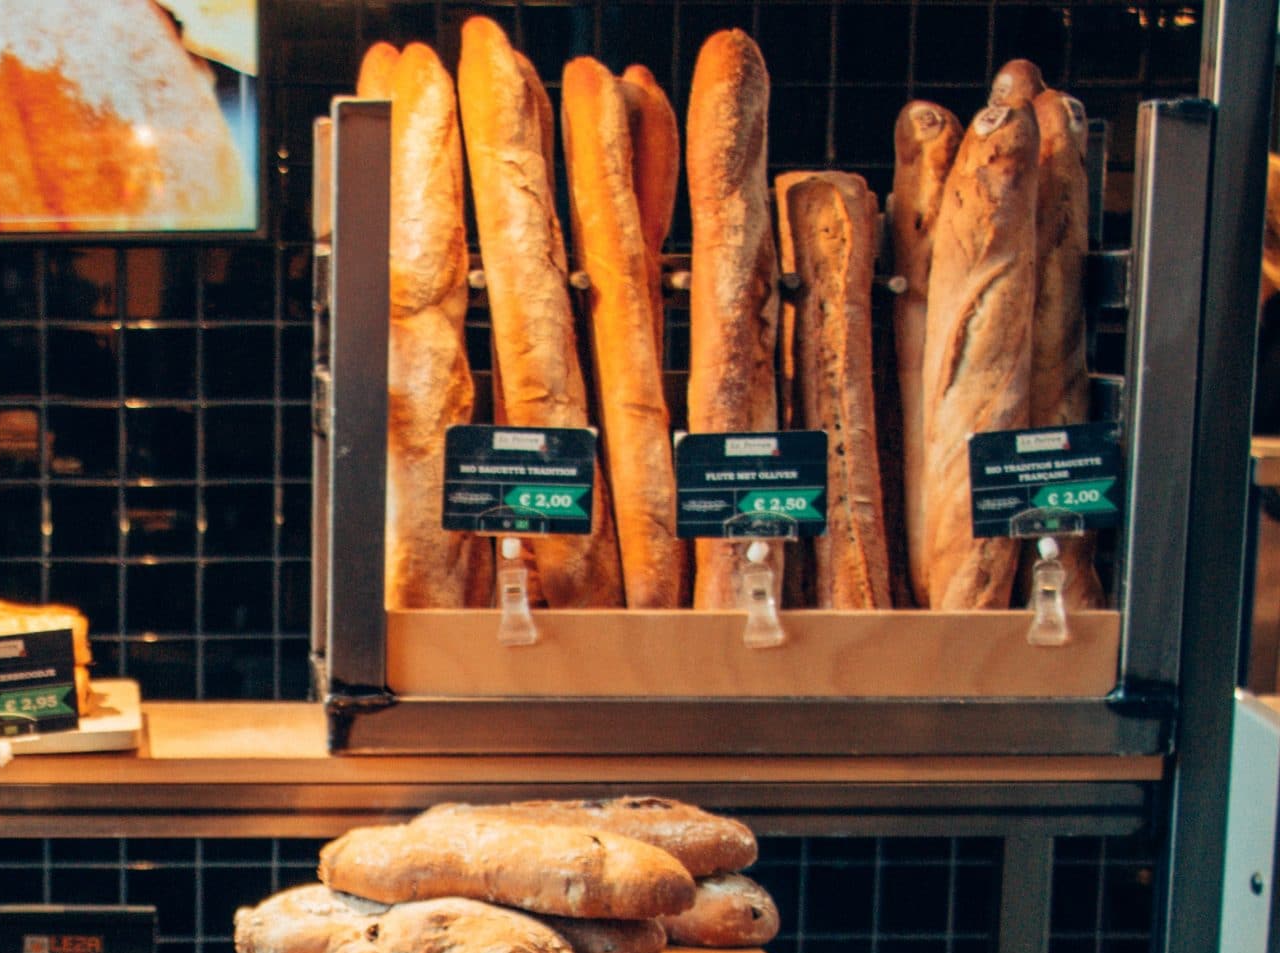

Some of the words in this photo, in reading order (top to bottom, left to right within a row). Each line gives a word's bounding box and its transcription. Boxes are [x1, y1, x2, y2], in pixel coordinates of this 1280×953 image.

[1003, 461, 1053, 473] TRADITION
[1054, 457, 1103, 469] BAGUETTE
[519, 494, 531, 507] €
[535, 493, 572, 509] 2,00
[753, 498, 765, 511] €
[770, 496, 807, 512] 2,50
[1047, 493, 1060, 506] €
[1063, 489, 1100, 506] 2,00
[4, 700, 17, 713] €
[21, 695, 58, 711] 2,95
